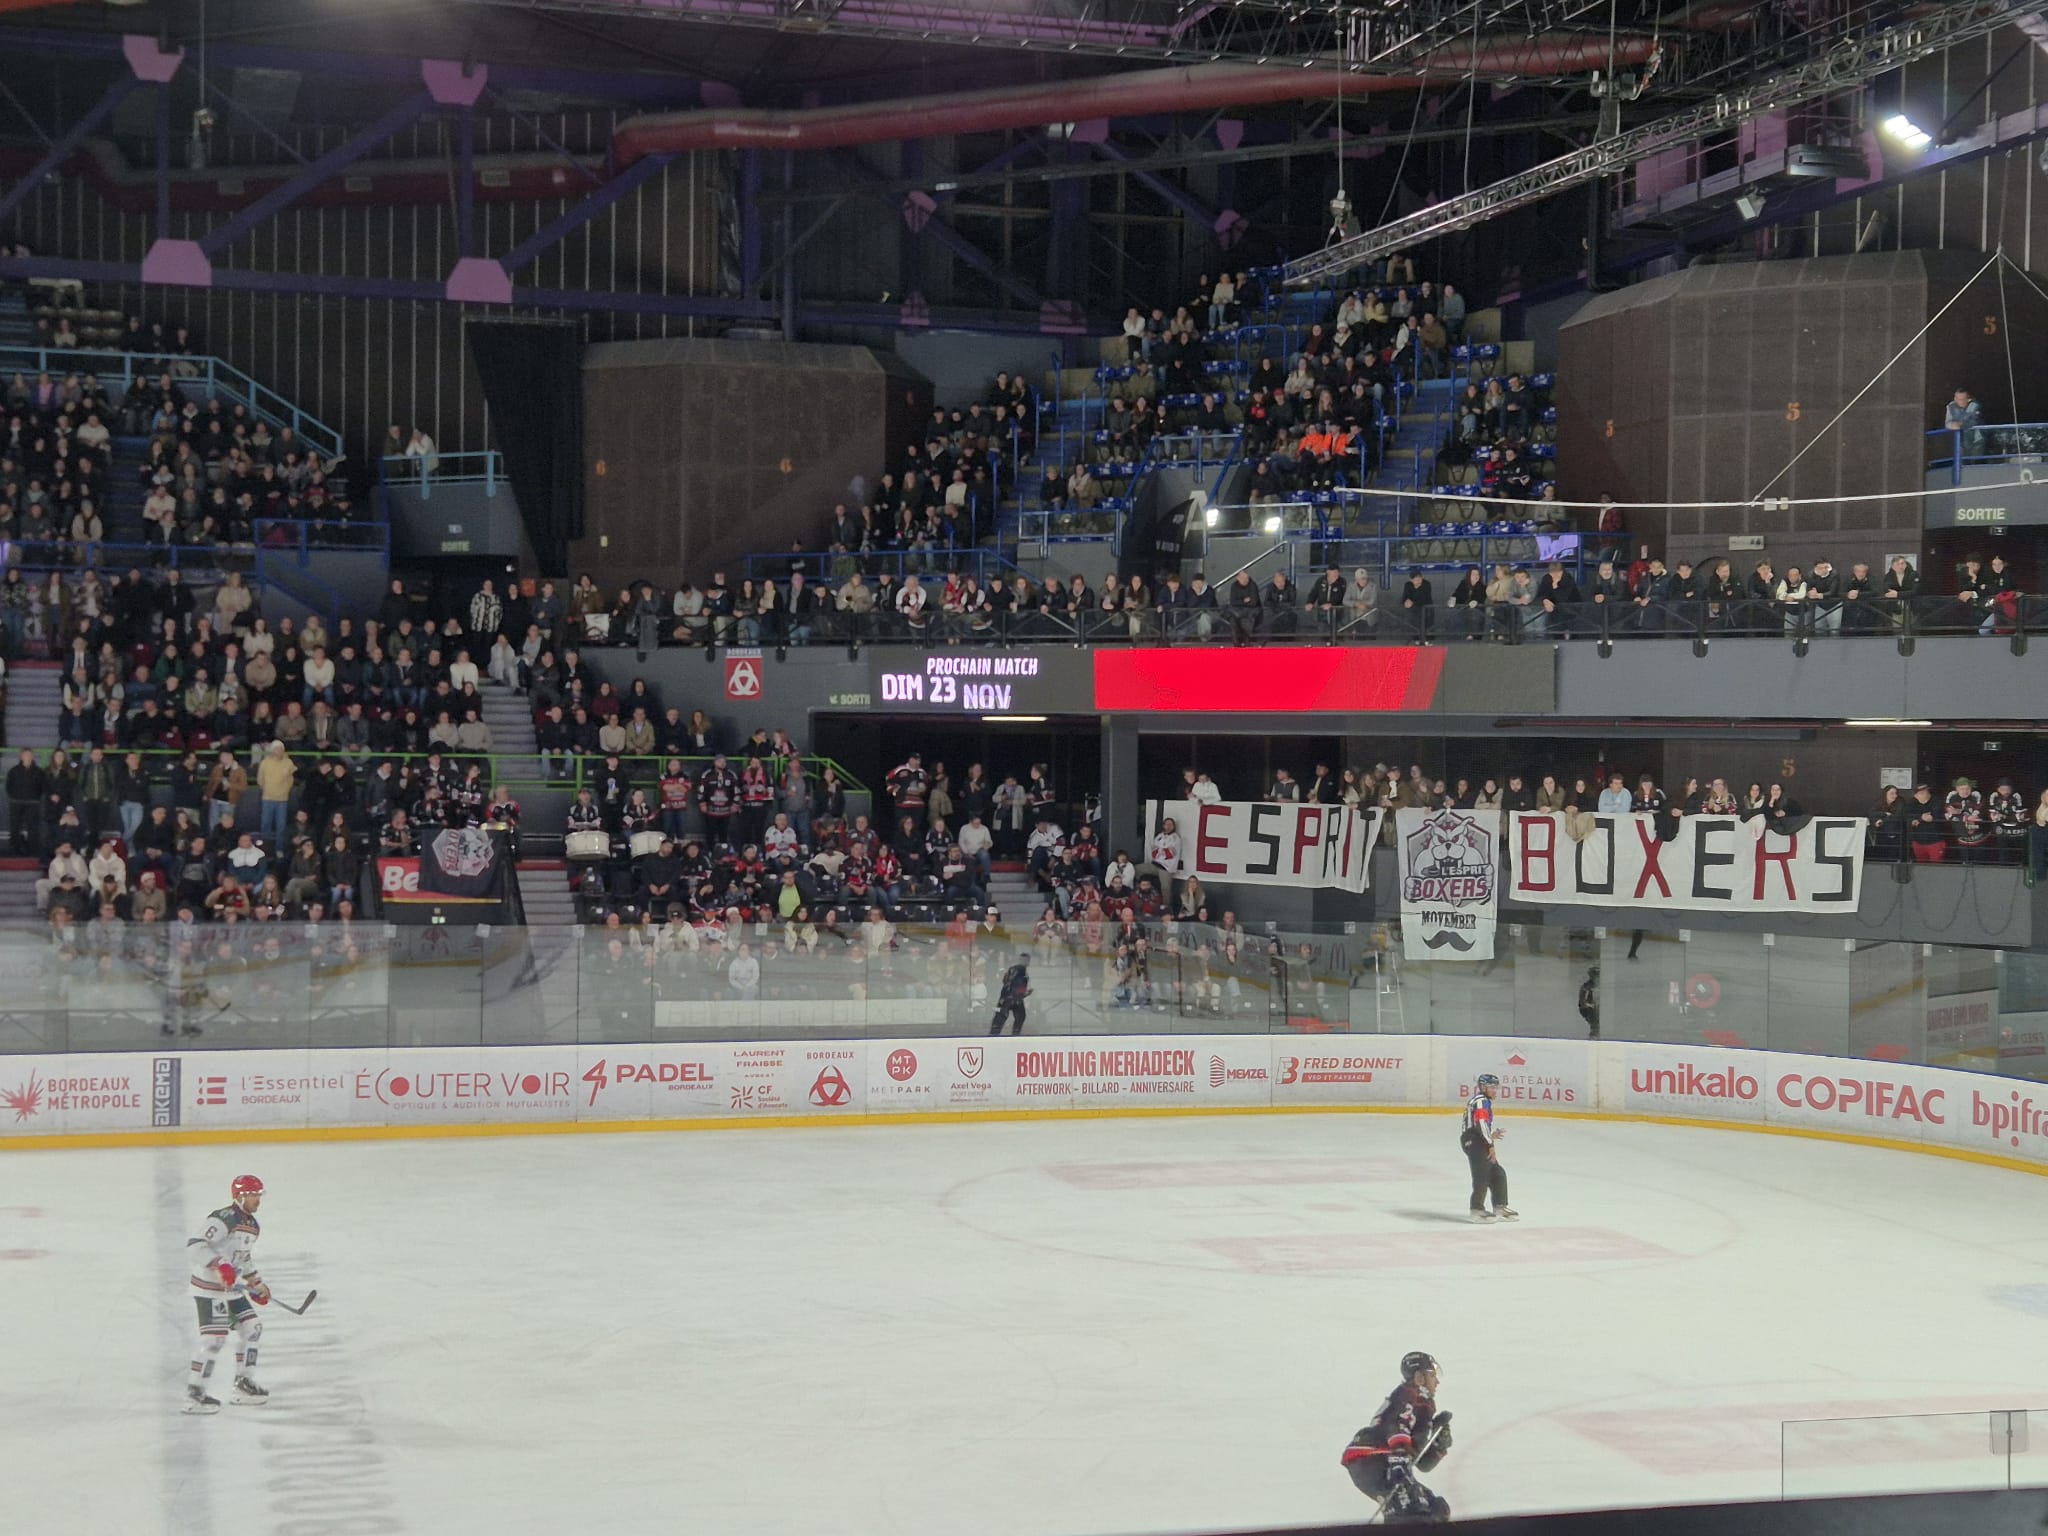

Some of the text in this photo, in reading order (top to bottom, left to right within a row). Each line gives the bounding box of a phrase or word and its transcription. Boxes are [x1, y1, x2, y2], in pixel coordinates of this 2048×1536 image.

[1785, 401, 1801, 422] 5
[1957, 508, 2006, 521] SORTIE
[926, 658, 1038, 675] PROCHAIN MATCH
[881, 673, 1011, 710] DIM 23 NOV
[1518, 815, 1856, 901] BOXERS
[1412, 878, 1488, 899] BOXERS
[1421, 911, 1477, 930] MOVEMBER
[806, 1051, 854, 1060] BORDEAUX
[1016, 1050, 1195, 1078] BOWLING MERIADECK
[1303, 1057, 1403, 1069] FRED BONNET
[616, 1063, 714, 1083] PADEL
[1226, 1068, 1269, 1080] MENZEL
[1503, 1075, 1561, 1086] BATEAUX
[1631, 1062, 1759, 1100] unikalo
[48, 1077, 131, 1093] BORDEAUX
[501, 1072, 570, 1097] VOIR
[758, 1085, 773, 1094] CF
[970, 1082, 992, 1090] Vega
[1016, 1081, 1195, 1095] AFTERWORK BILLARD ANNIVERSAIRE
[48, 1092, 141, 1111] MÉTROPOLE
[242, 1095, 301, 1104] BORDEAUX
[1460, 1085, 1575, 1102] BDELAIS
[1776, 1074, 1945, 1125] COPIFAC
[453, 1101, 500, 1109] AUDITION
[506, 1100, 570, 1108] MUTUALISTES
